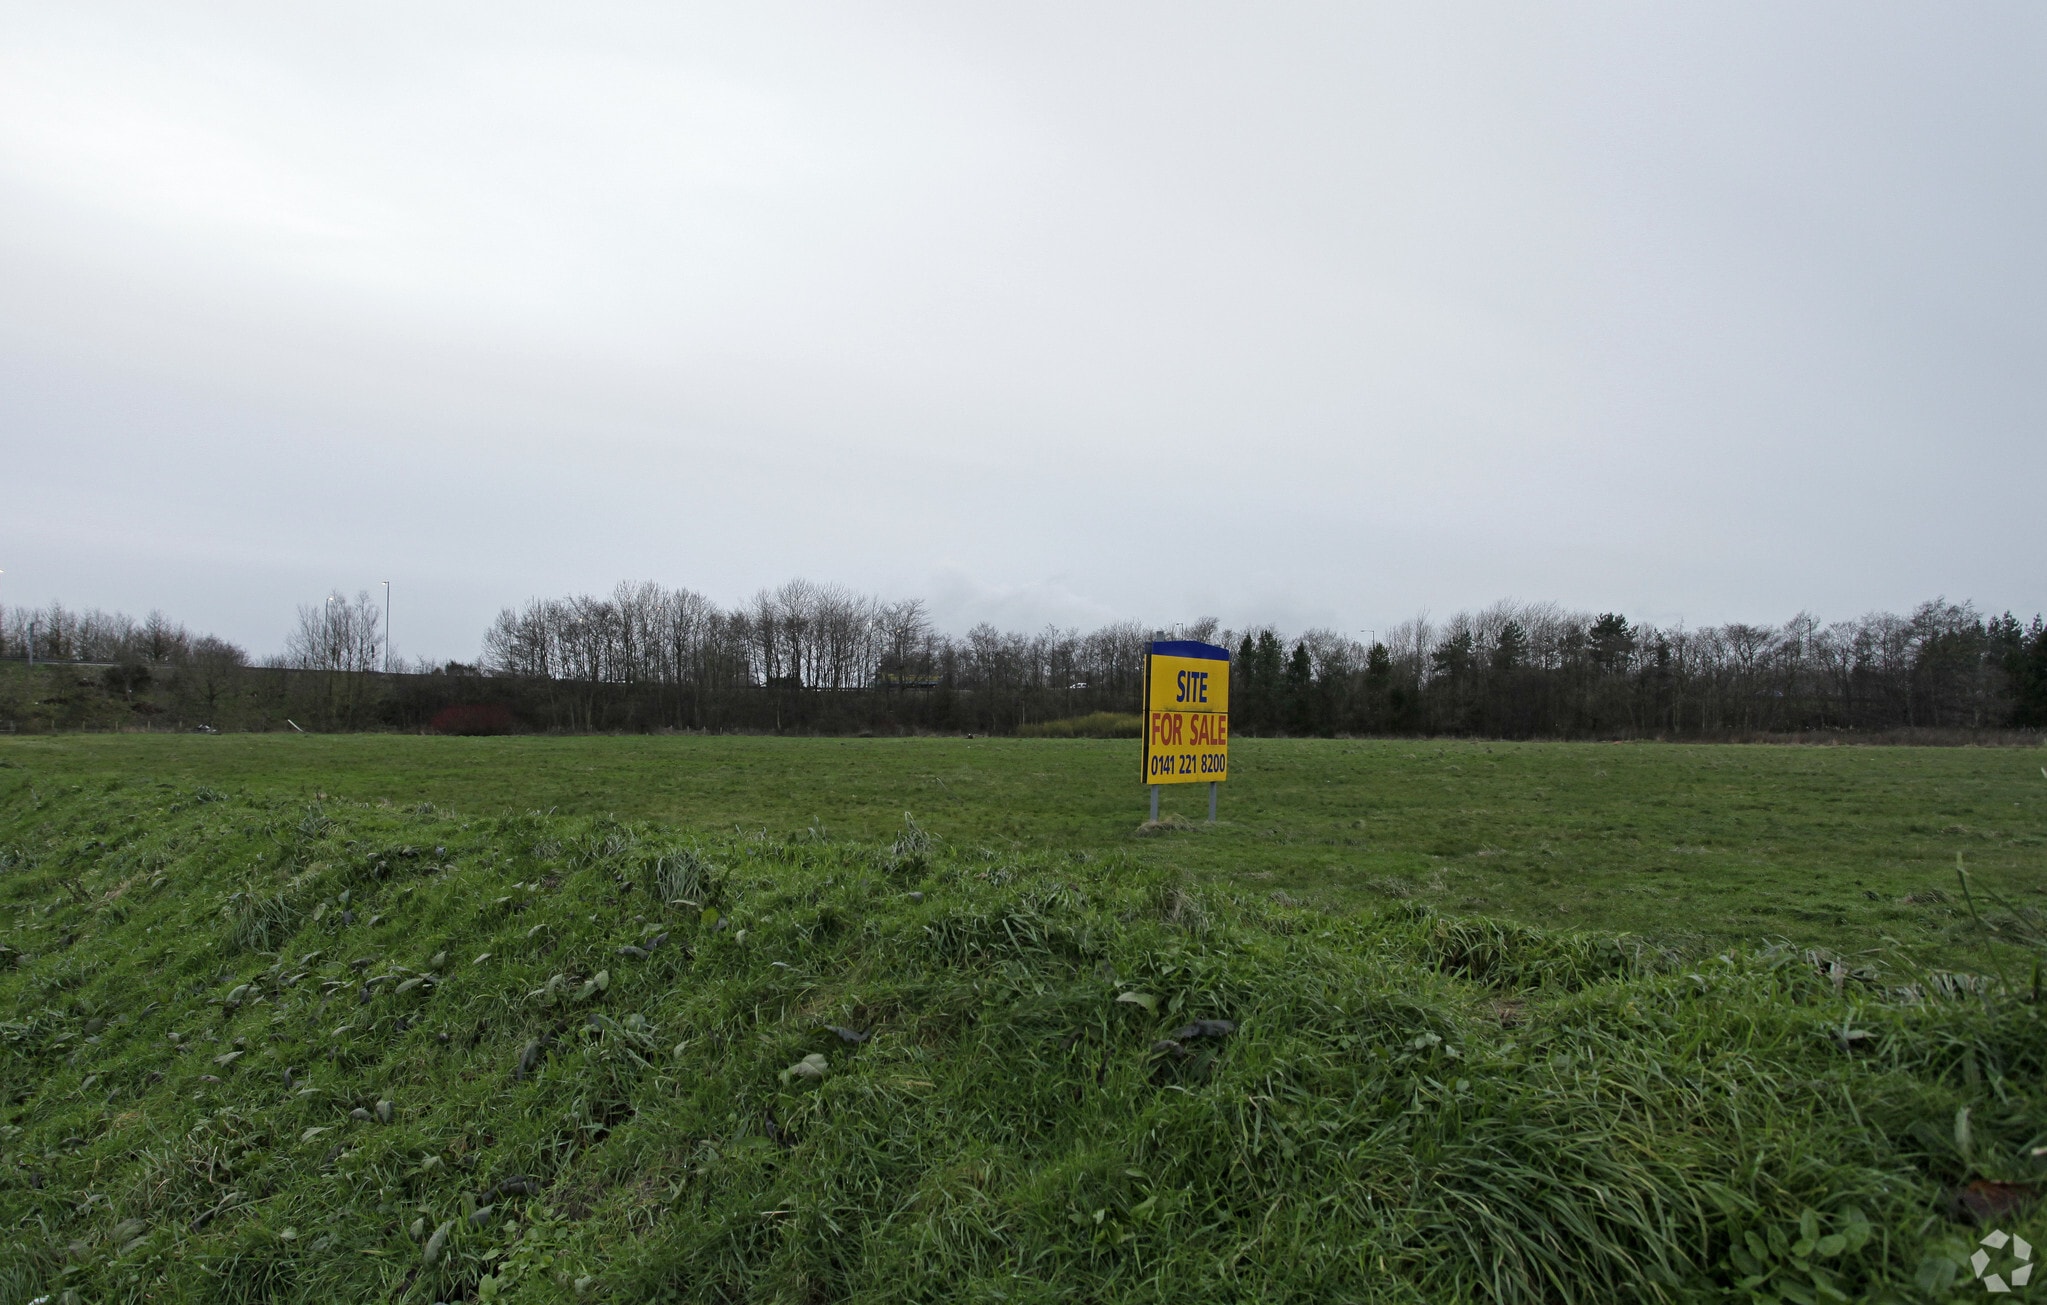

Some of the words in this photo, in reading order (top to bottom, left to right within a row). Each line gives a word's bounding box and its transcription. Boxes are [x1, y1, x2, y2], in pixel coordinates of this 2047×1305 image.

[1176, 670, 1208, 703] SITE
[1151, 712, 1183, 746] FOR
[1189, 713, 1226, 746] SALE
[1151, 755, 1175, 775] 0141
[1179, 754, 1196, 774] 221
[1201, 753, 1226, 773] 8200
